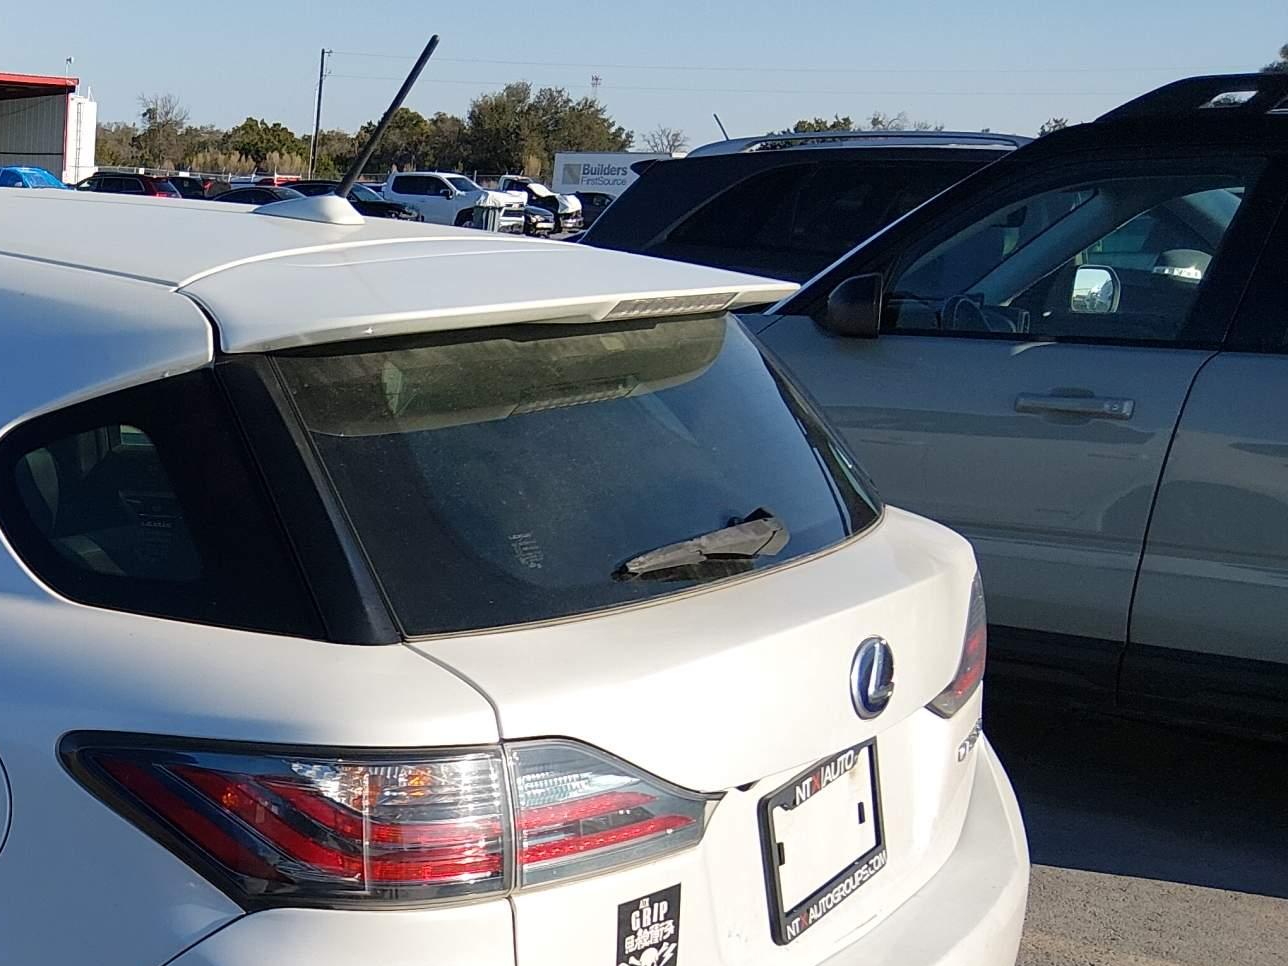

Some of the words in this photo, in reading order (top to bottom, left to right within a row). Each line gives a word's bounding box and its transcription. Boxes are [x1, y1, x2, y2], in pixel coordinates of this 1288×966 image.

[582, 163, 628, 176] Builders
[580, 176, 626, 186] FirstSource
[631, 900, 668, 931] GRIP
